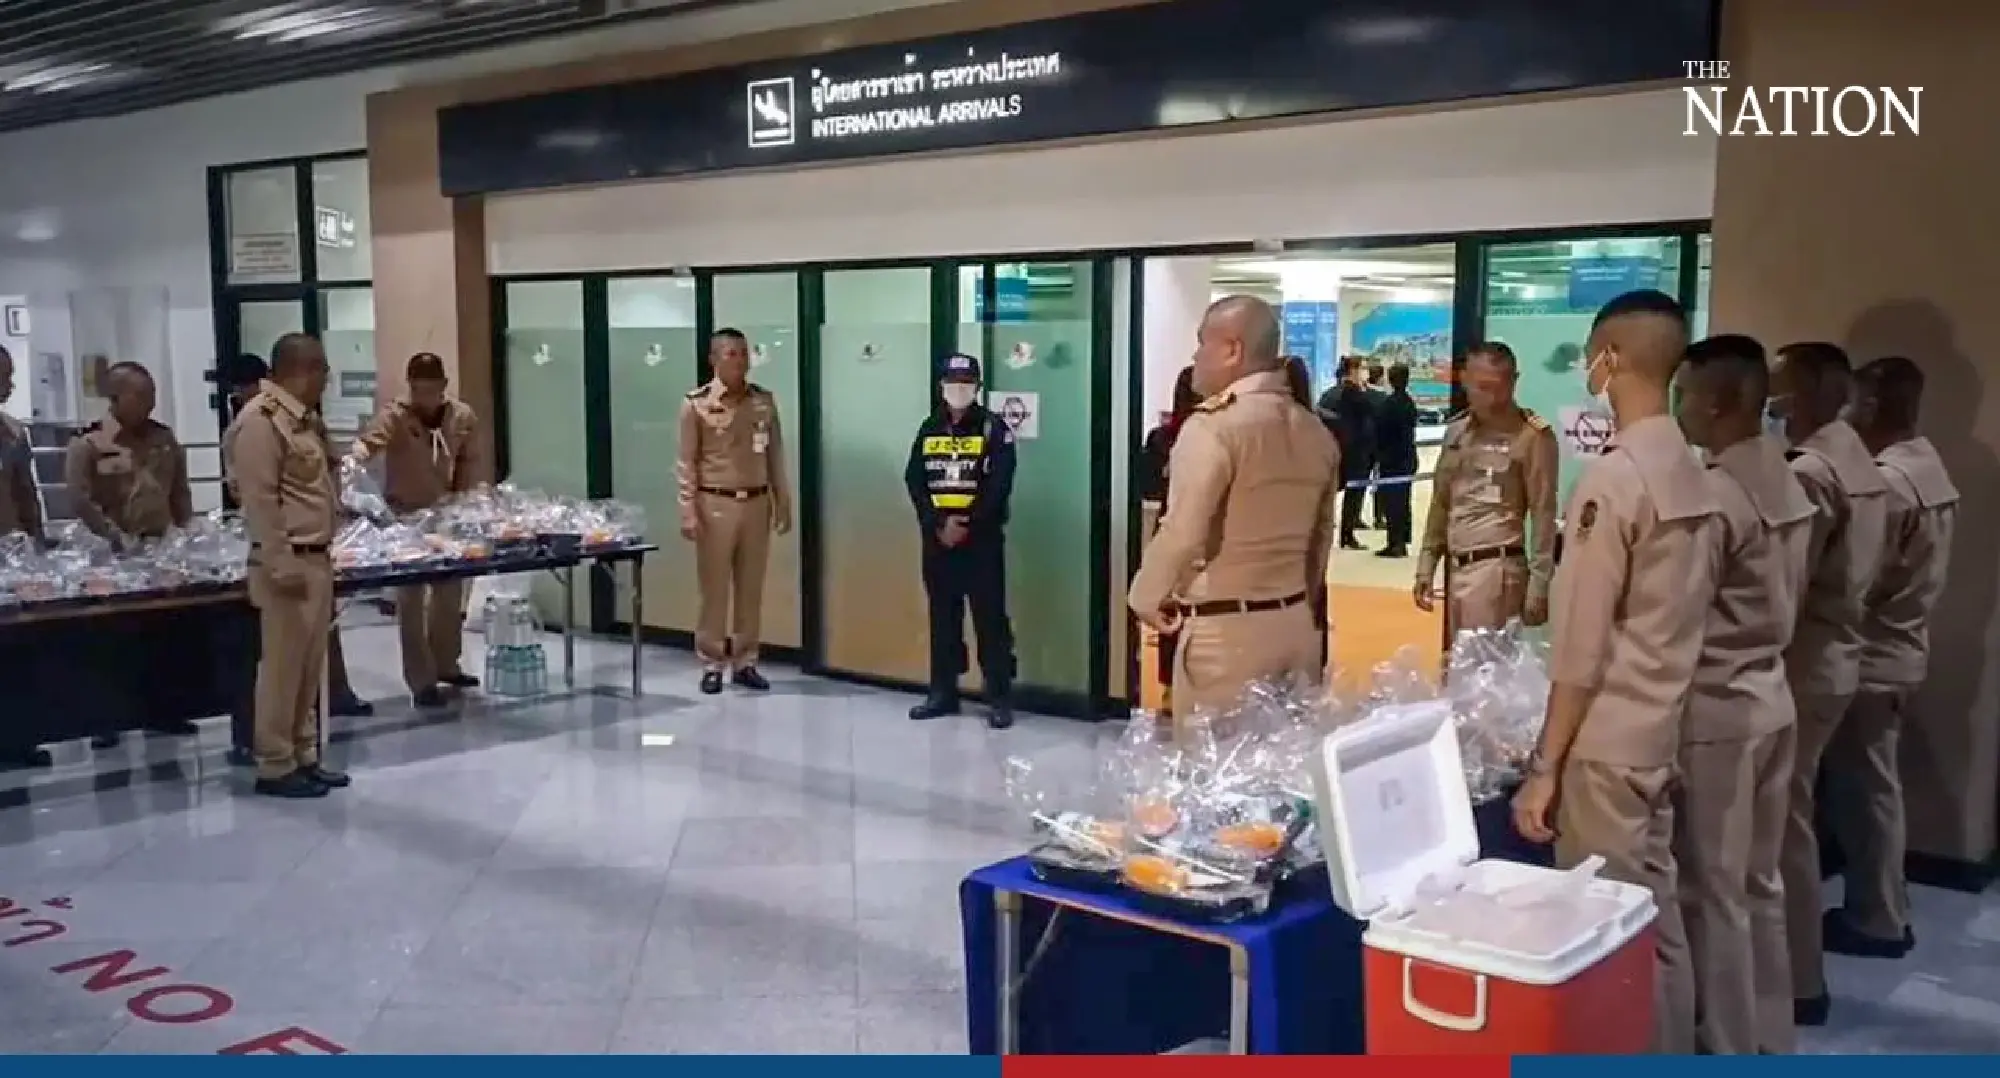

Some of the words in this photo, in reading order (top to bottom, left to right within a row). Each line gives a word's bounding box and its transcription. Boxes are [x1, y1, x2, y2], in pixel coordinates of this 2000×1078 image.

[931, 46, 1061, 91] ระหว่างประเทศ
[811, 105, 935, 138] INTERNATIONAL
[937, 94, 1023, 125] ARRIVALS
[50, 949, 234, 1024] NO
